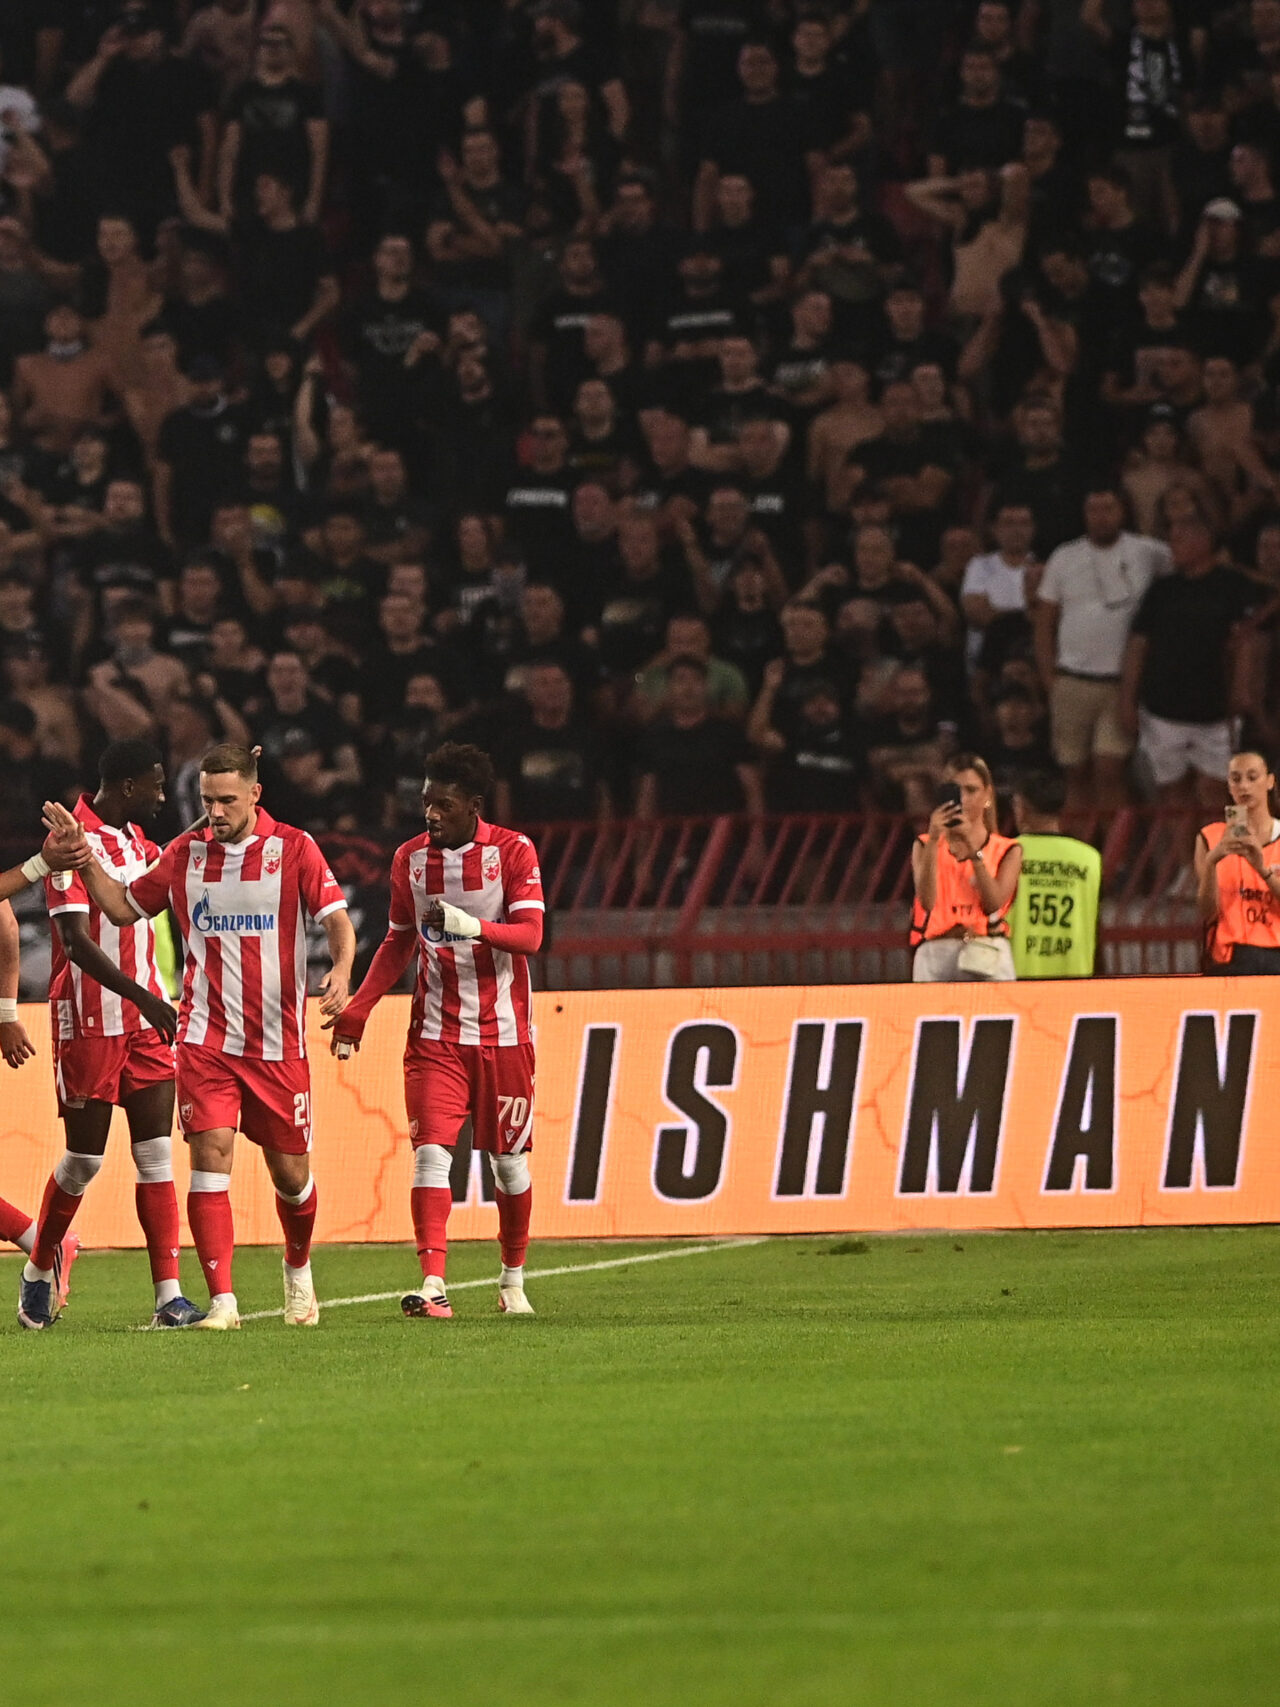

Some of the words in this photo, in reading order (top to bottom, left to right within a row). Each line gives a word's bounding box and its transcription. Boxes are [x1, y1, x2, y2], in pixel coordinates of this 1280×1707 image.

[214, 914, 274, 931] GAZPROM
[1029, 893, 1074, 928] 552
[497, 1095, 528, 1127] 70
